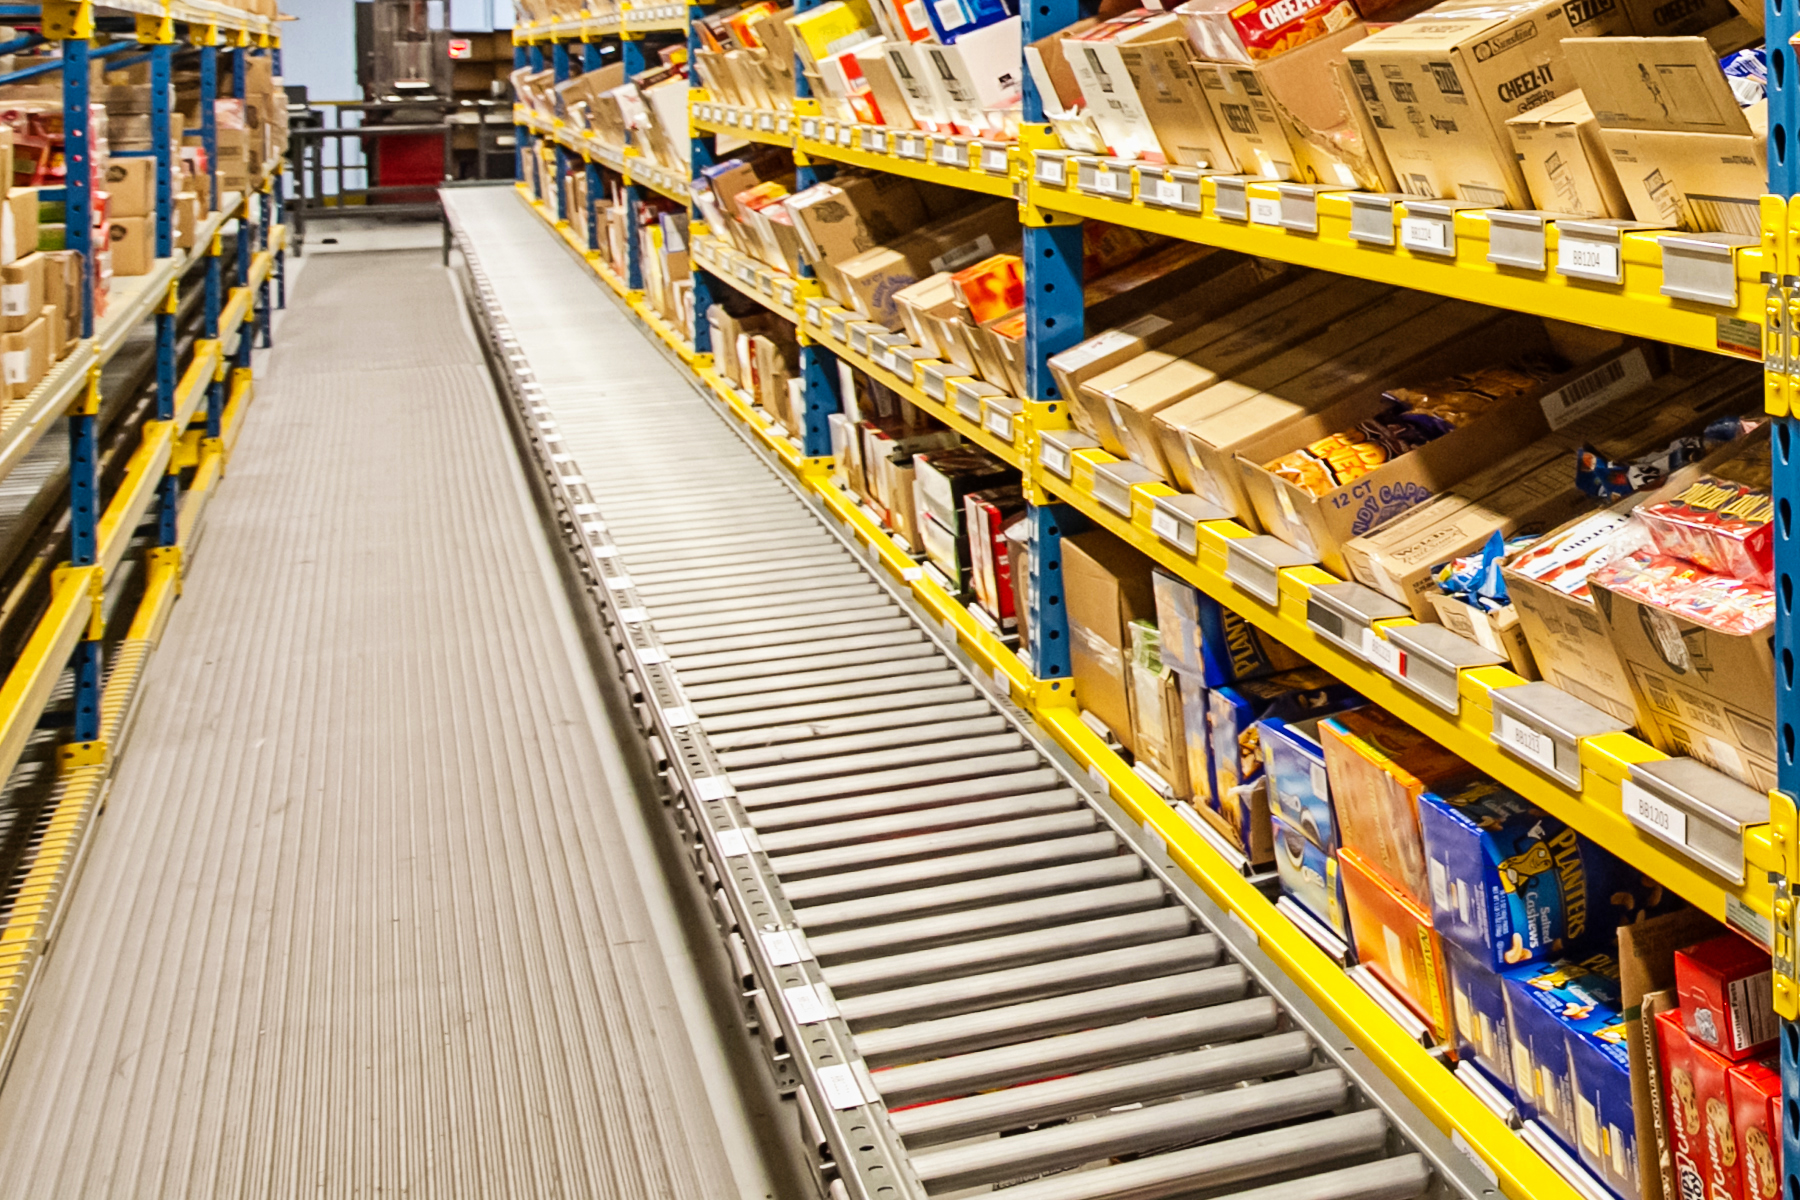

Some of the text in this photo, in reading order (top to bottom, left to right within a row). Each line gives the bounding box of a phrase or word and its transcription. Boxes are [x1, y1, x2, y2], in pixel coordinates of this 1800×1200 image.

[1498, 63, 1555, 104] CHEEZ-IT
[1572, 249, 1600, 267] BB1204
[1332, 479, 1373, 510] 12 CT
[1638, 798, 1669, 830] BB1203
[1549, 828, 1587, 940] PLANTERS
[1526, 891, 1540, 949] Cashews
[1539, 905, 1553, 945] Salted
